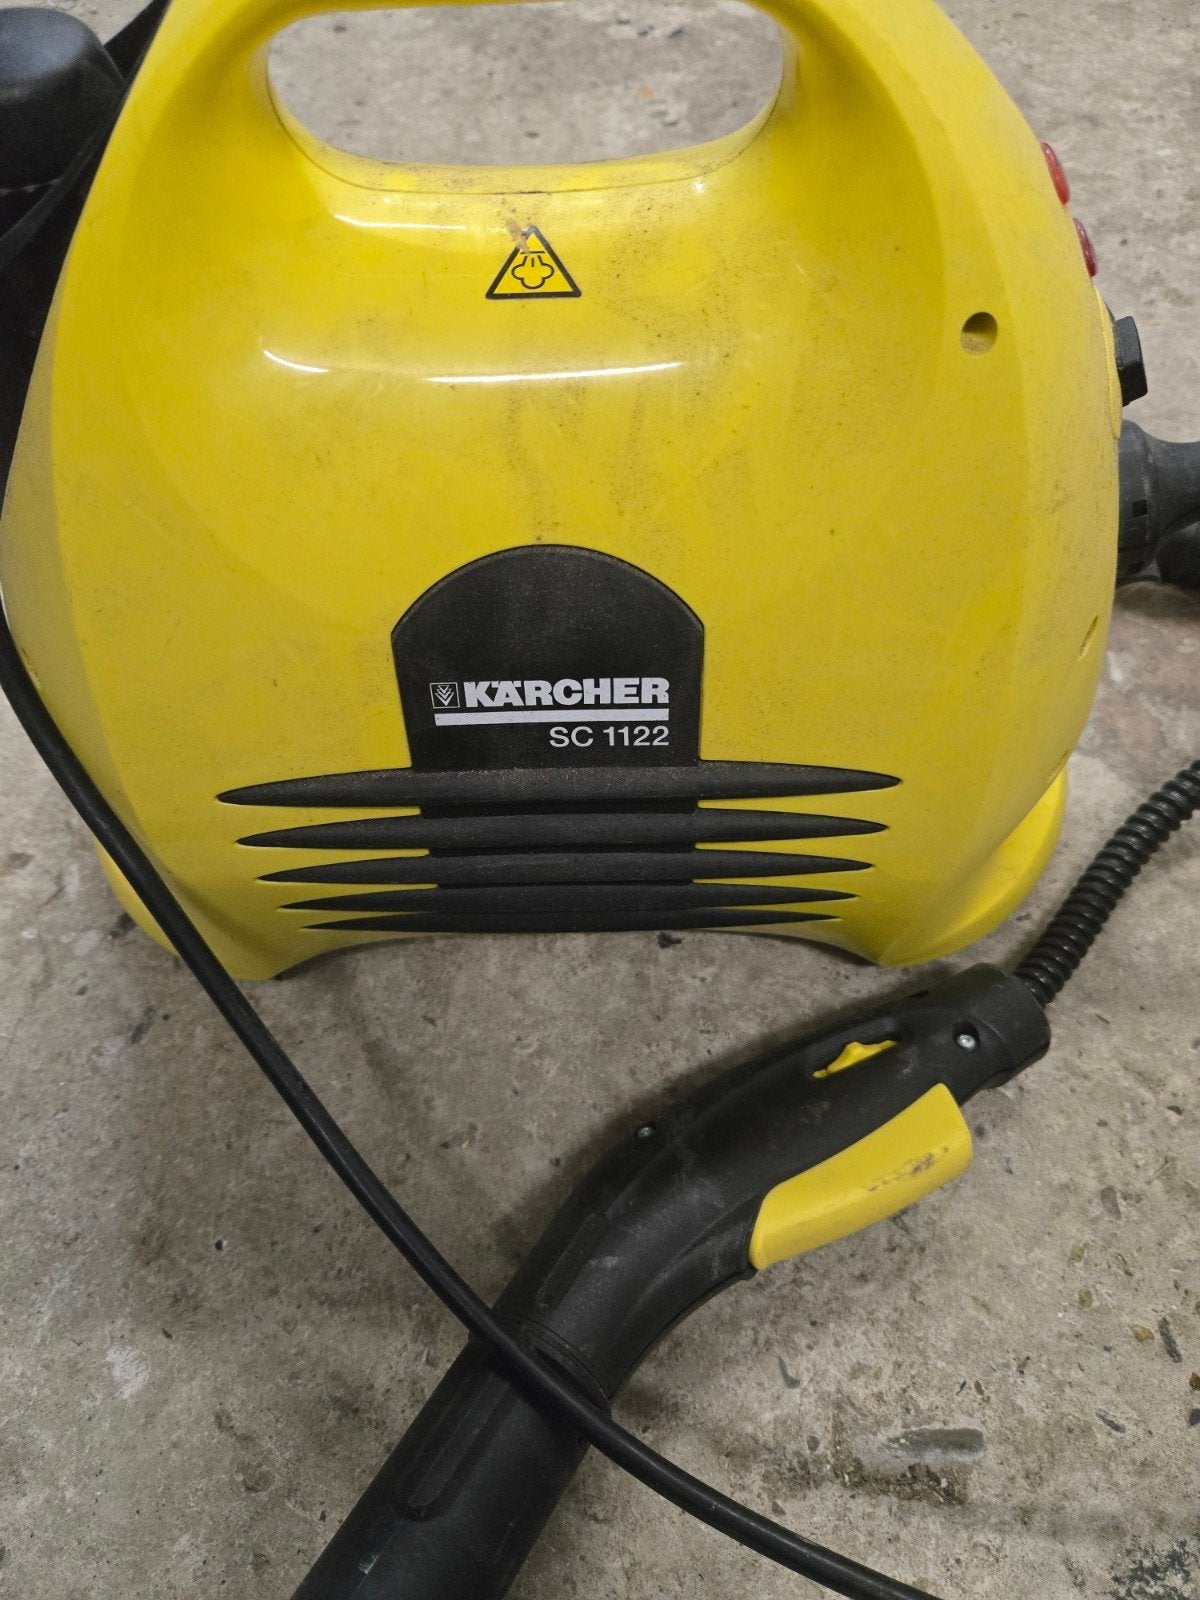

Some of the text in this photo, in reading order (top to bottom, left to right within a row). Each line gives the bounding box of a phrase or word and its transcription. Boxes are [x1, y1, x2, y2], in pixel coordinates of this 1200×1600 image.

[463, 677, 670, 708] KÄRCHER
[549, 725, 670, 748] SC 1122
